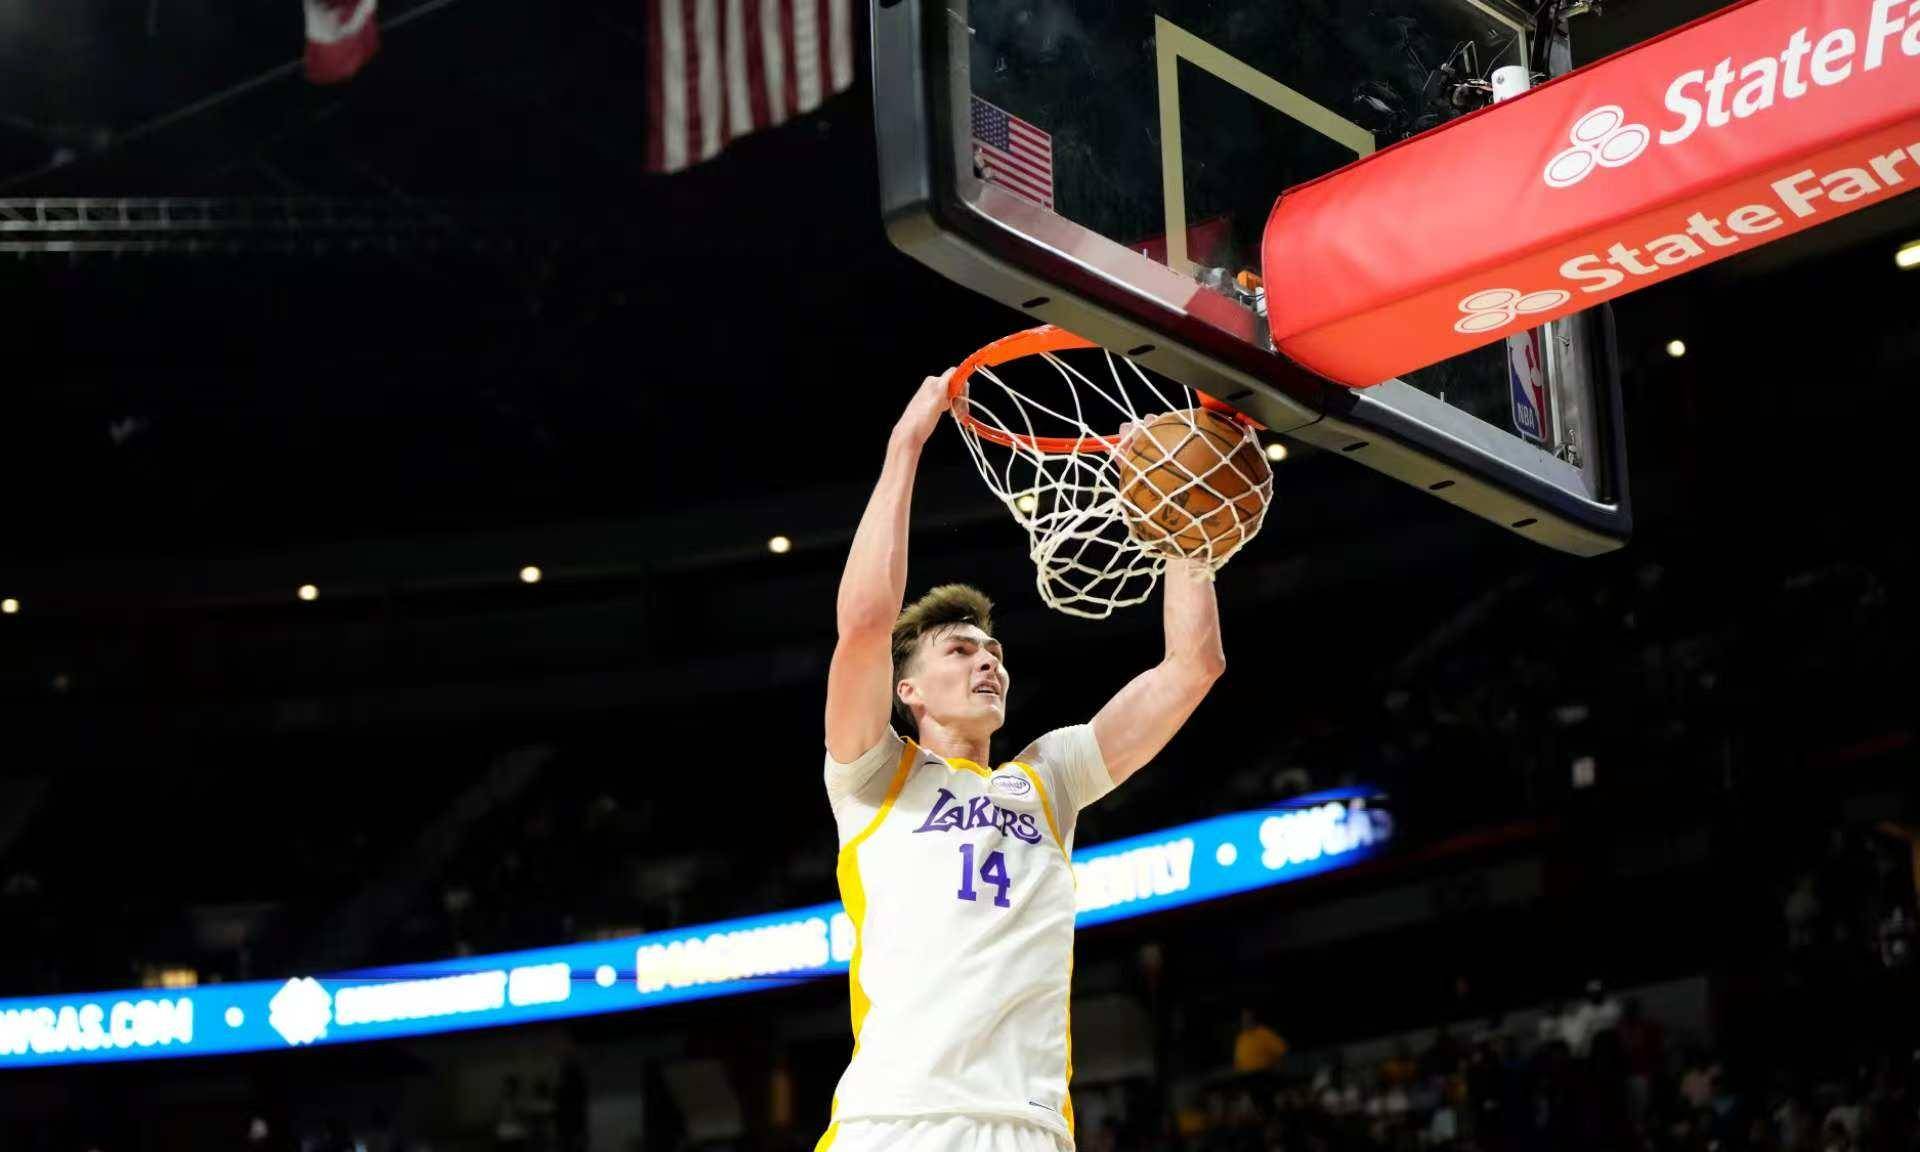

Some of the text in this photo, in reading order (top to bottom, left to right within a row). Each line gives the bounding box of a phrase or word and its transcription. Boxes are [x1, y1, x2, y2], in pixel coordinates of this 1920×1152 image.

[1770, 143, 1920, 218] Far
[1517, 402, 1535, 430] NBA
[957, 843, 1011, 908] 14
